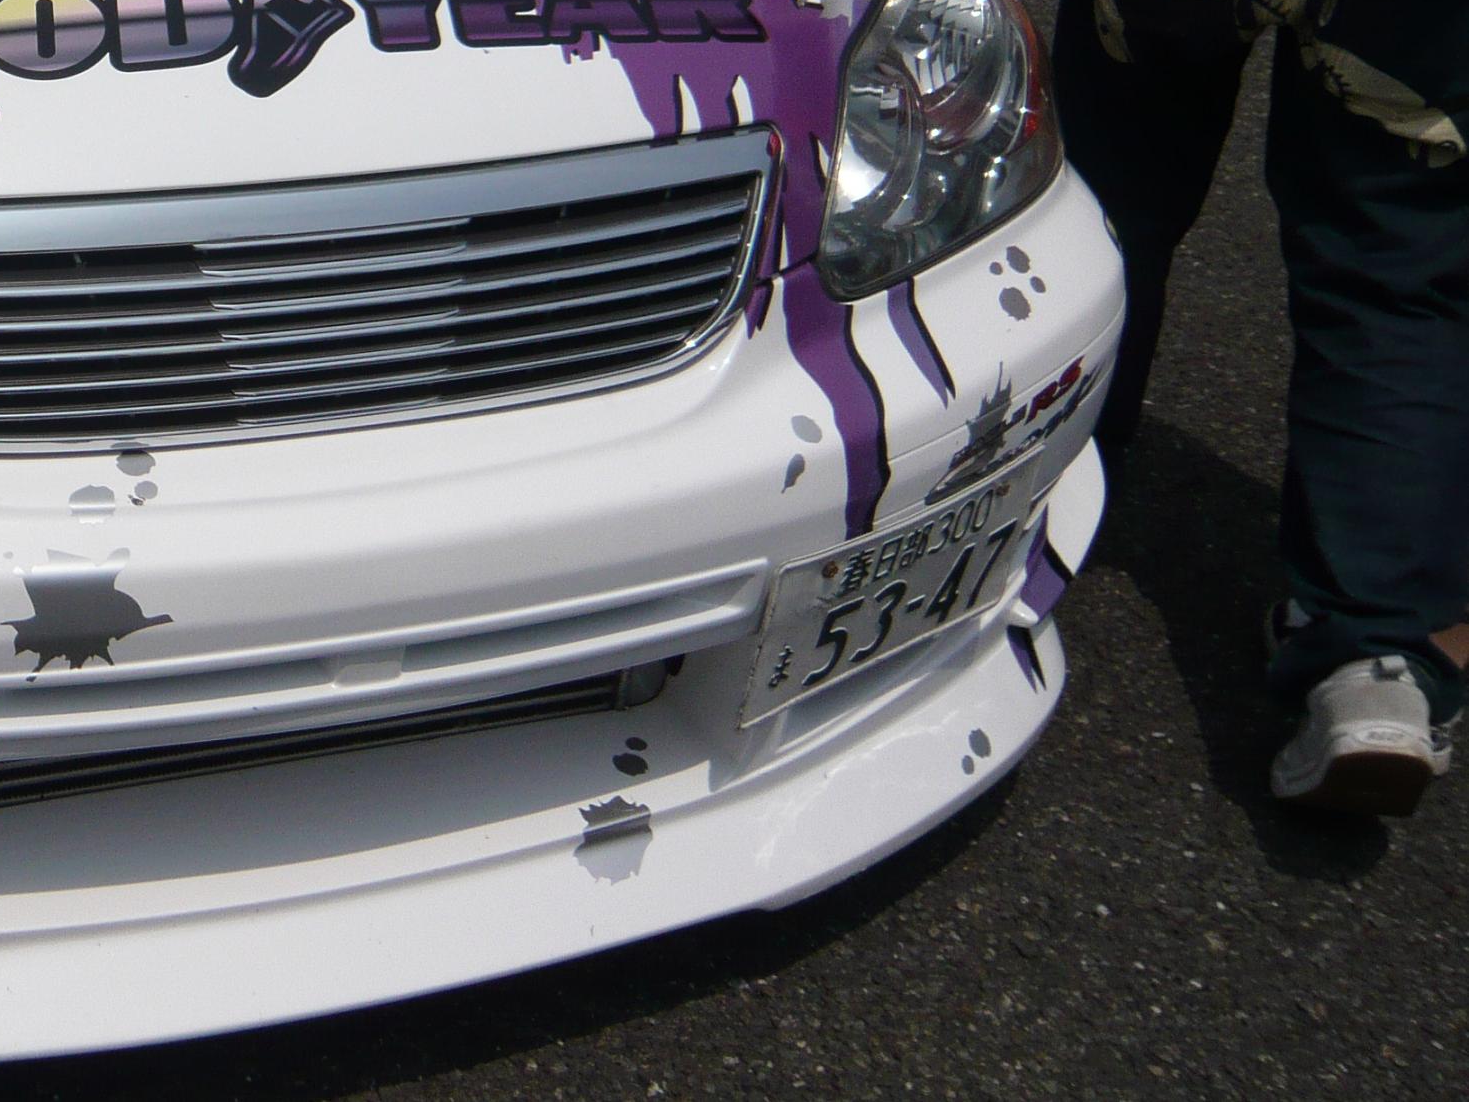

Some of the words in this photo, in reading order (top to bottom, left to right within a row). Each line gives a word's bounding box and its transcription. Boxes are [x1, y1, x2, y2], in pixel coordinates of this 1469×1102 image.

[801, 517, 1019, 687] 53-47
[838, 517, 935, 594] 春日部
[927, 488, 995, 558] 300
